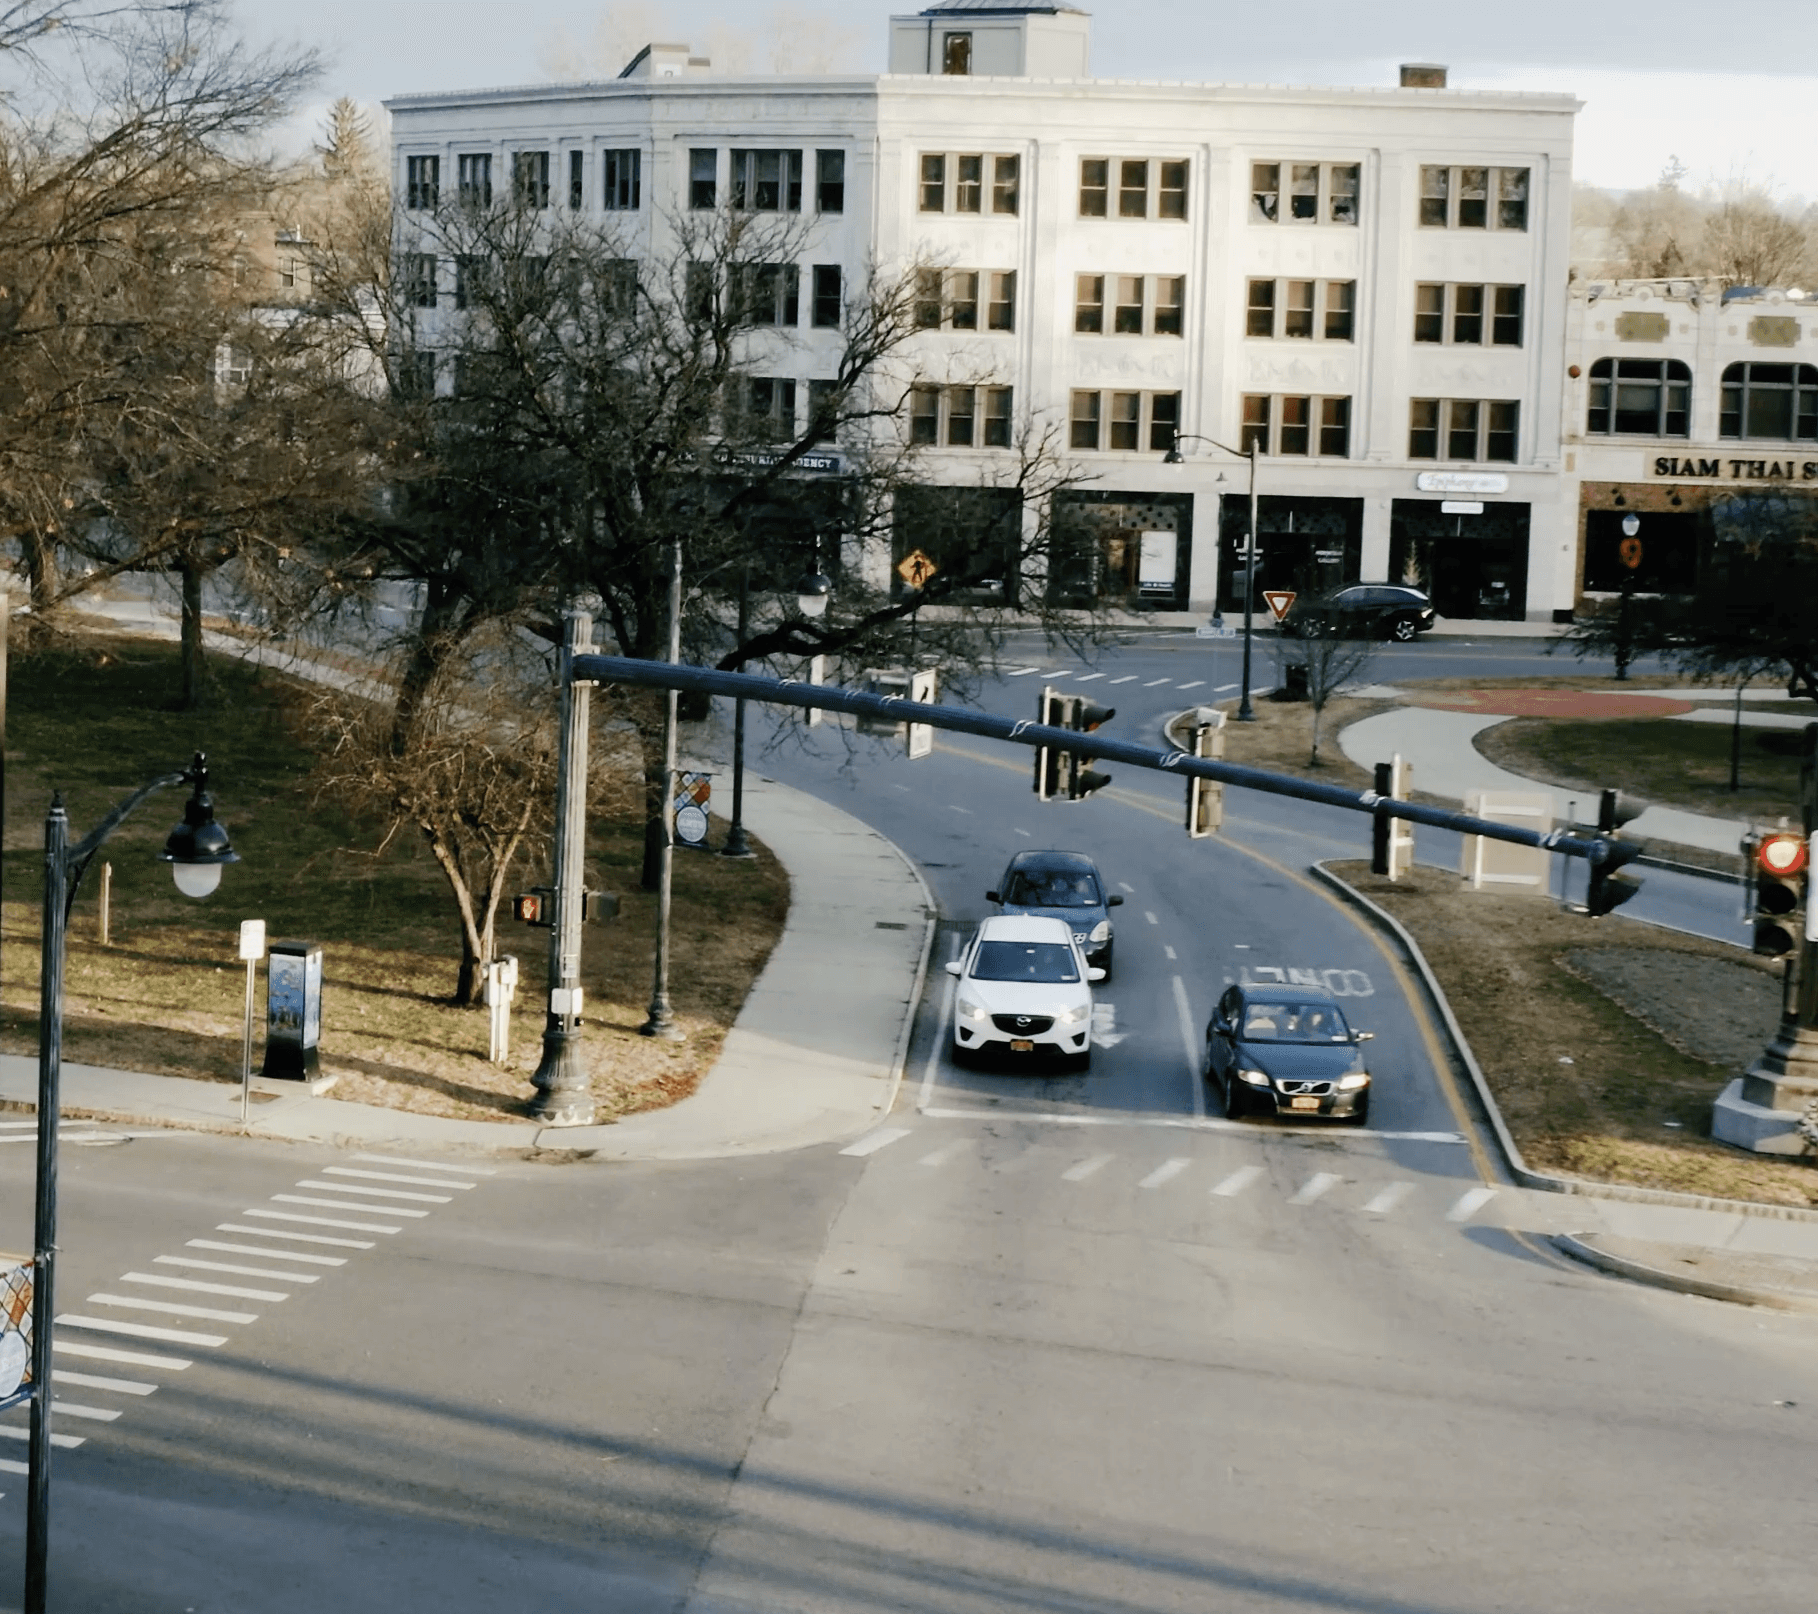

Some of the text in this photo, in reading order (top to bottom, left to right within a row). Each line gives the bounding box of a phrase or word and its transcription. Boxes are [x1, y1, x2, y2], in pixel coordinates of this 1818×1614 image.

[791, 457, 832, 469] GENCY
[1654, 457, 1818, 481] SIAM THAI S
